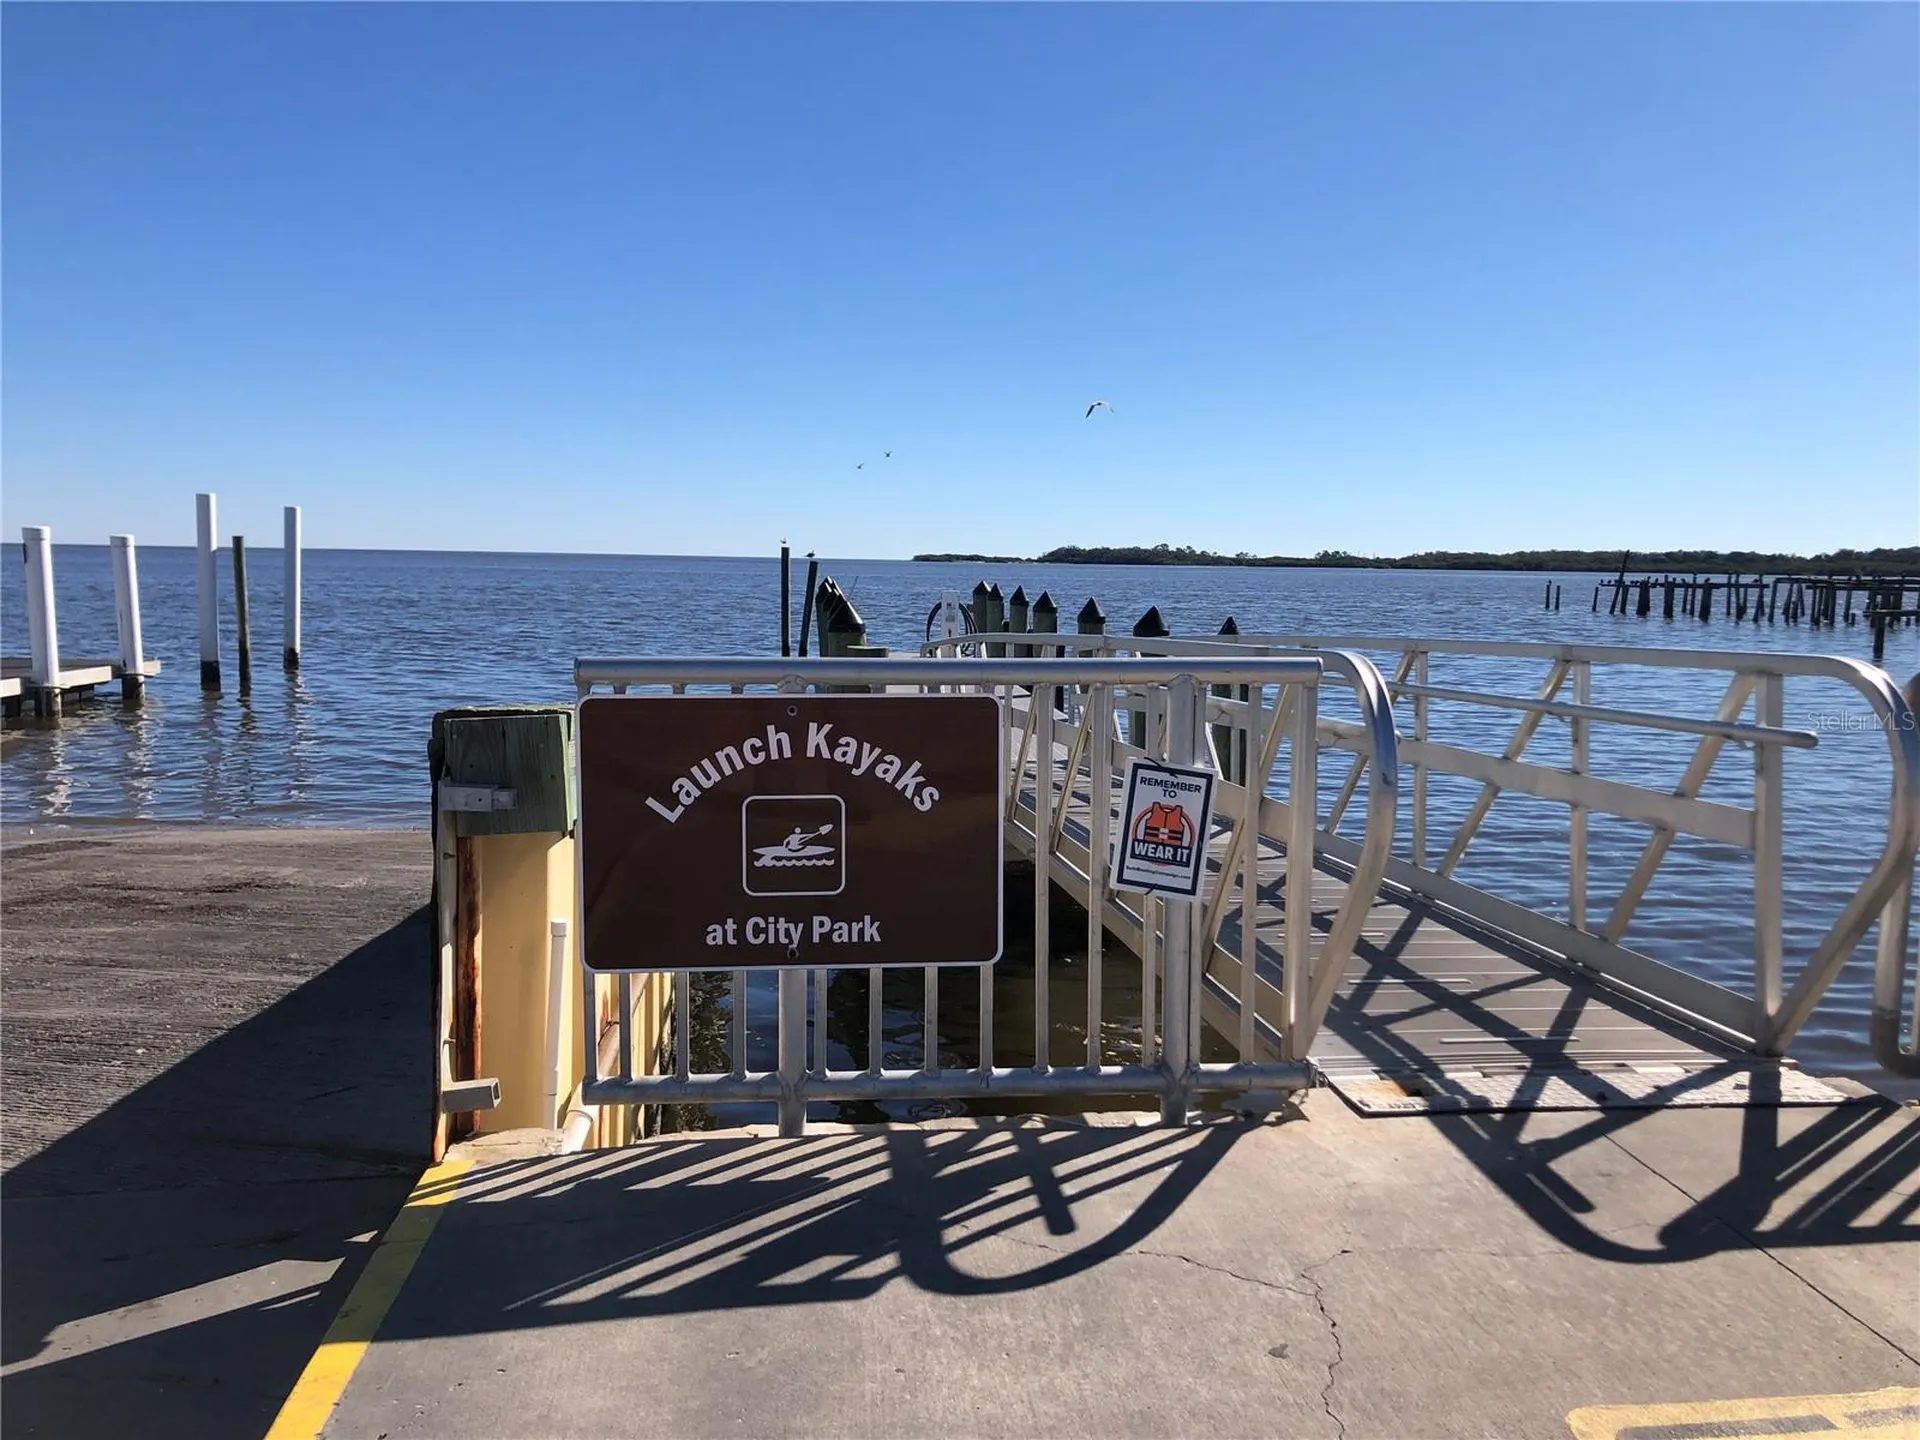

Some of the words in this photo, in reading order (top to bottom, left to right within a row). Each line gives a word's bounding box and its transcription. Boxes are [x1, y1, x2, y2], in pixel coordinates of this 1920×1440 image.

[645, 725, 792, 823] Launch
[806, 722, 940, 812] Kayaks
[1139, 776, 1202, 794] REMEMBER
[1161, 788, 1177, 799] TO
[1134, 841, 1173, 860] WEAR
[1176, 847, 1190, 862] IT
[705, 918, 738, 945] at
[746, 916, 803, 948] City
[812, 915, 882, 944] Park
